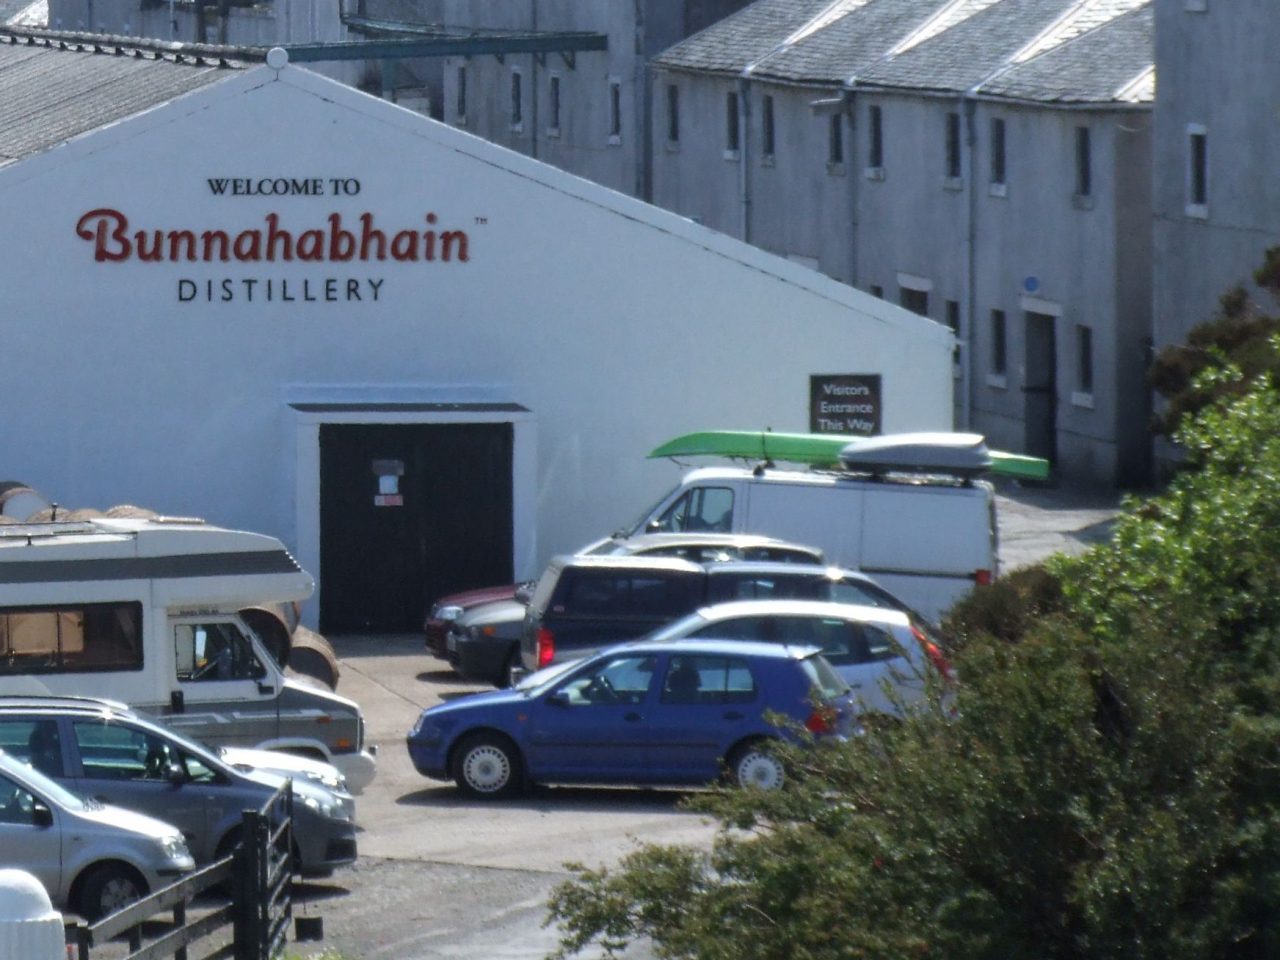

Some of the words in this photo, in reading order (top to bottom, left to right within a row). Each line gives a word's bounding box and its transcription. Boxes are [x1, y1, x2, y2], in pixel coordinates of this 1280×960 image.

[208, 179, 323, 196] WELCOME
[330, 179, 360, 196] TO
[76, 208, 470, 262] Bunnahabhain
[178, 279, 385, 301] DISTILLERY
[823, 384, 870, 395] Visitors
[820, 401, 873, 413] Entrance
[819, 418, 844, 430] This
[847, 419, 875, 433] Way
